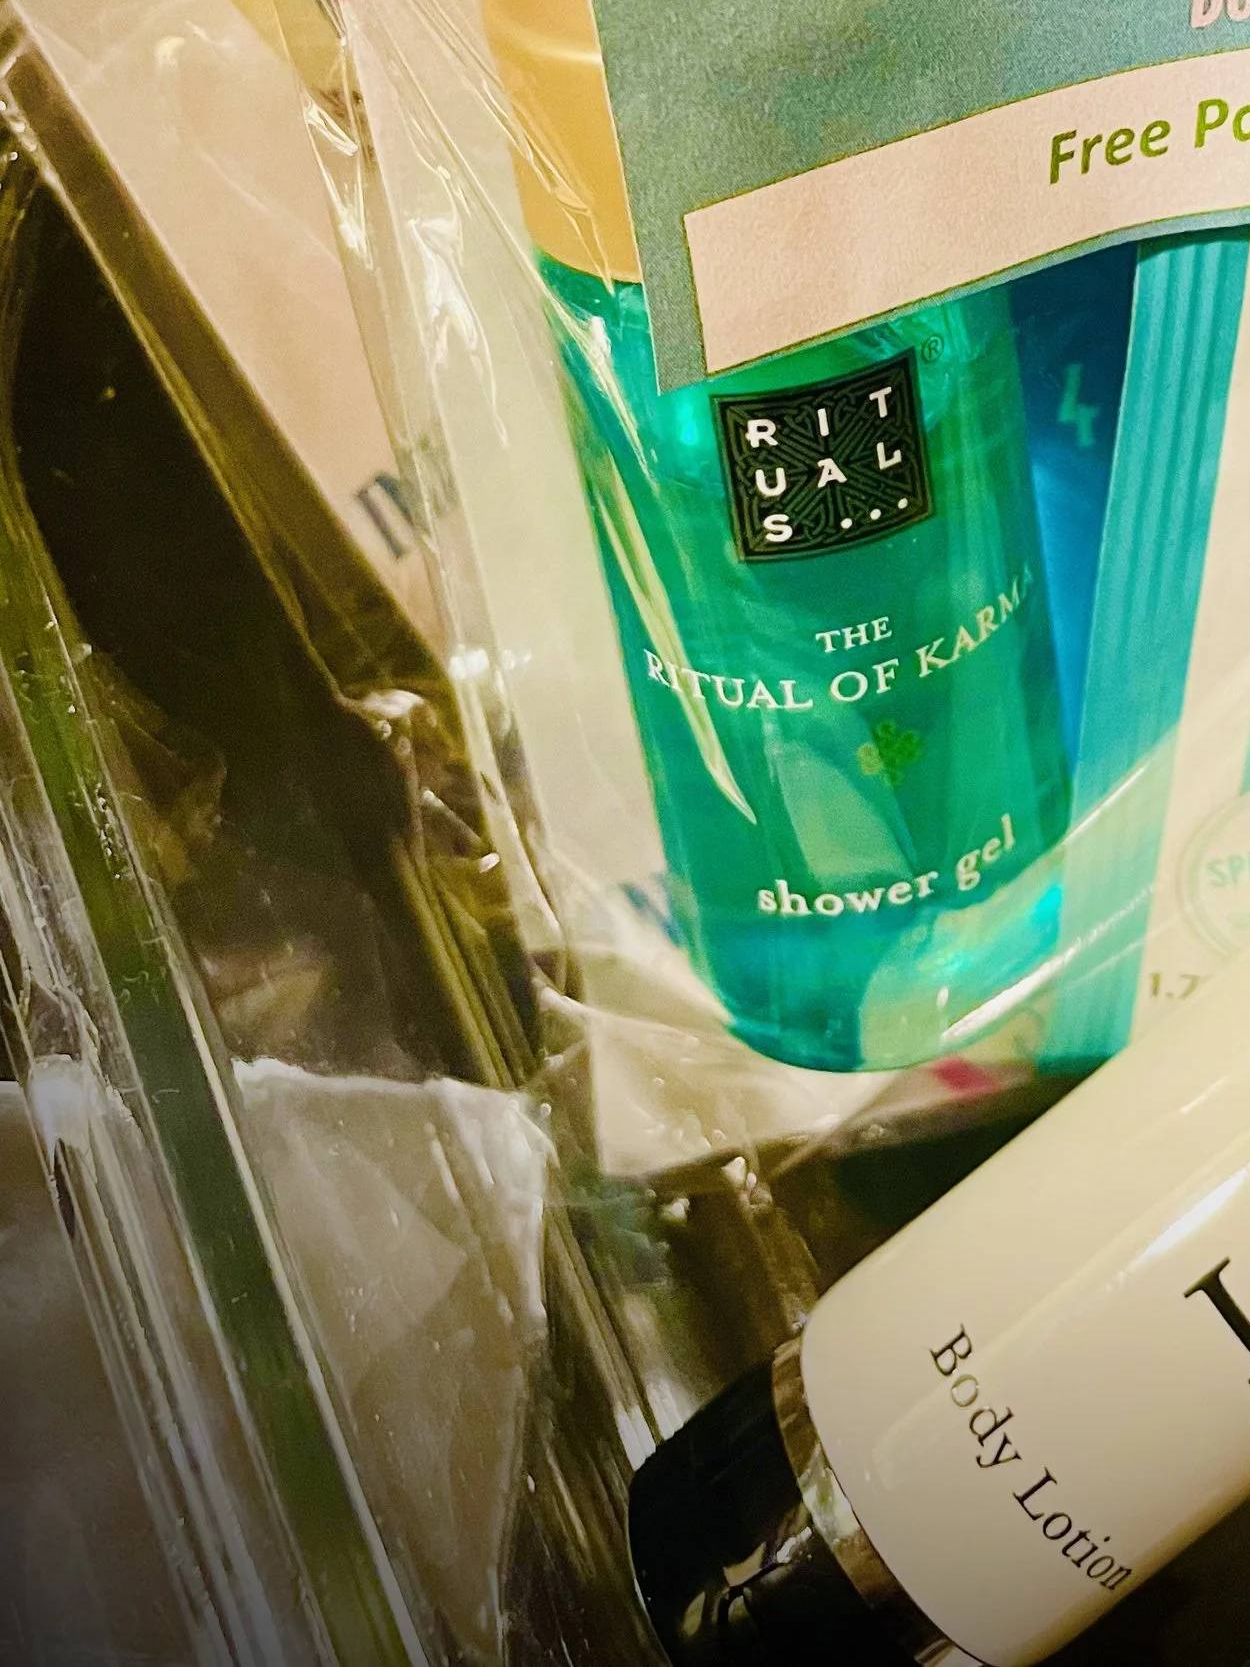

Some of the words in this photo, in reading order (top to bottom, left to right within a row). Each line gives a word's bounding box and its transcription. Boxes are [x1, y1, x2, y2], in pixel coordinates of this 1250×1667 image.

[1048, 114, 1170, 184] Free
[816, 617, 893, 653] THE
[643, 648, 813, 709] RITUAL
[830, 658, 900, 703] OF
[757, 869, 939, 918] shower
[955, 813, 1016, 891] gel
[929, 1323, 1021, 1471] Body
[1011, 1466, 1134, 1593] Lotion
